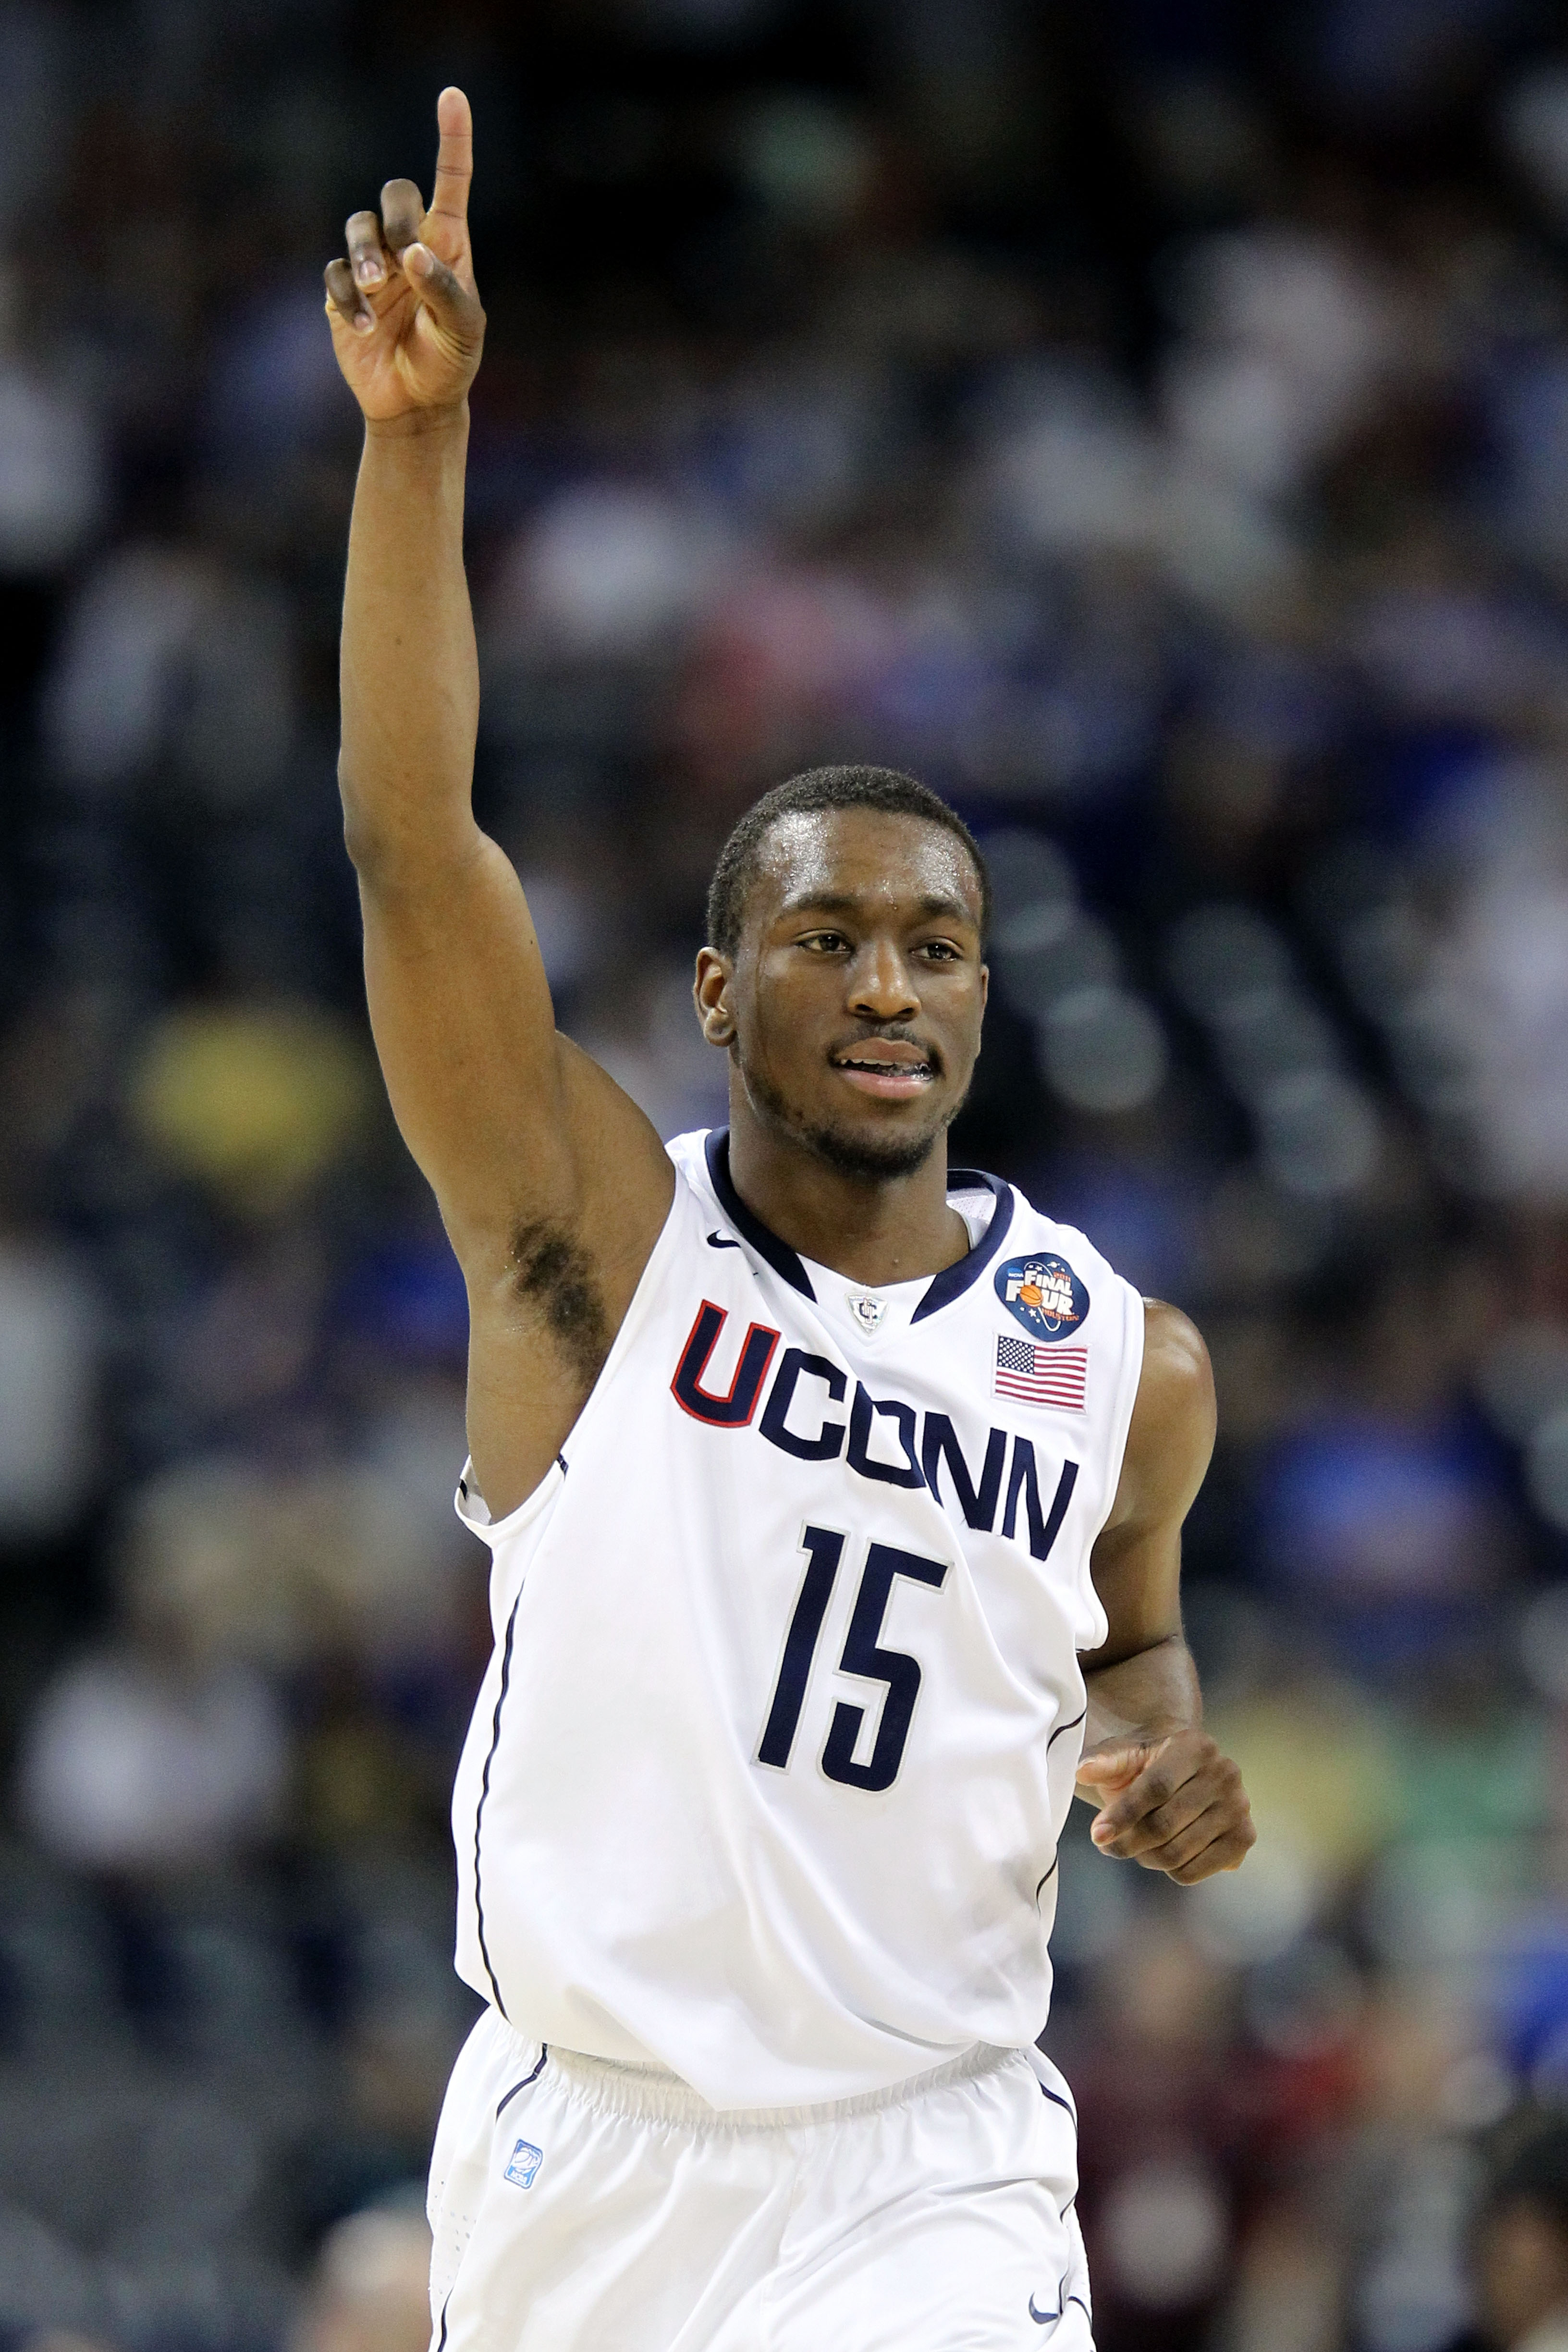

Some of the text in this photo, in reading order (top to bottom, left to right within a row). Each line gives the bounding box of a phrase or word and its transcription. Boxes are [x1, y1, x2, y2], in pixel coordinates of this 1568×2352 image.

[1005, 1279, 1075, 1315] FOUR
[1024, 1270, 1073, 1296] FINAL
[1041, 1307, 1079, 1322] HOUSTON
[670, 1298, 1079, 1560] UCONN
[751, 1519, 955, 1793] 15
